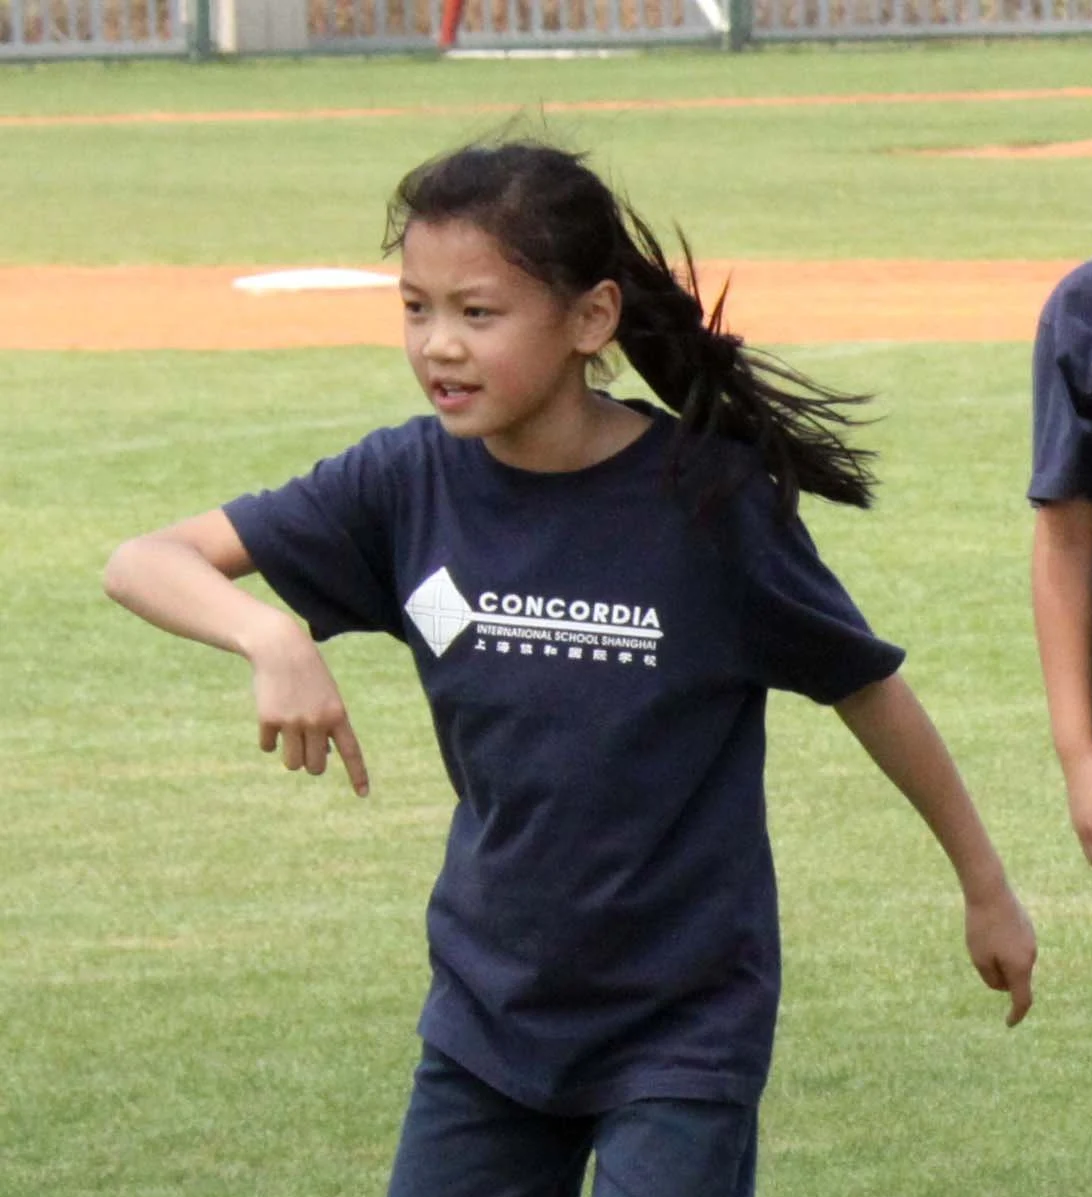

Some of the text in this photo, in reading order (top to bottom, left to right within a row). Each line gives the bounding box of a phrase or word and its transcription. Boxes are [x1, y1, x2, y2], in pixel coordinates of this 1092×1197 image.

[478, 591, 661, 628] CONCORDIA
[476, 623, 657, 651] INTERNATIONAL SCHOOL SHANGHAI
